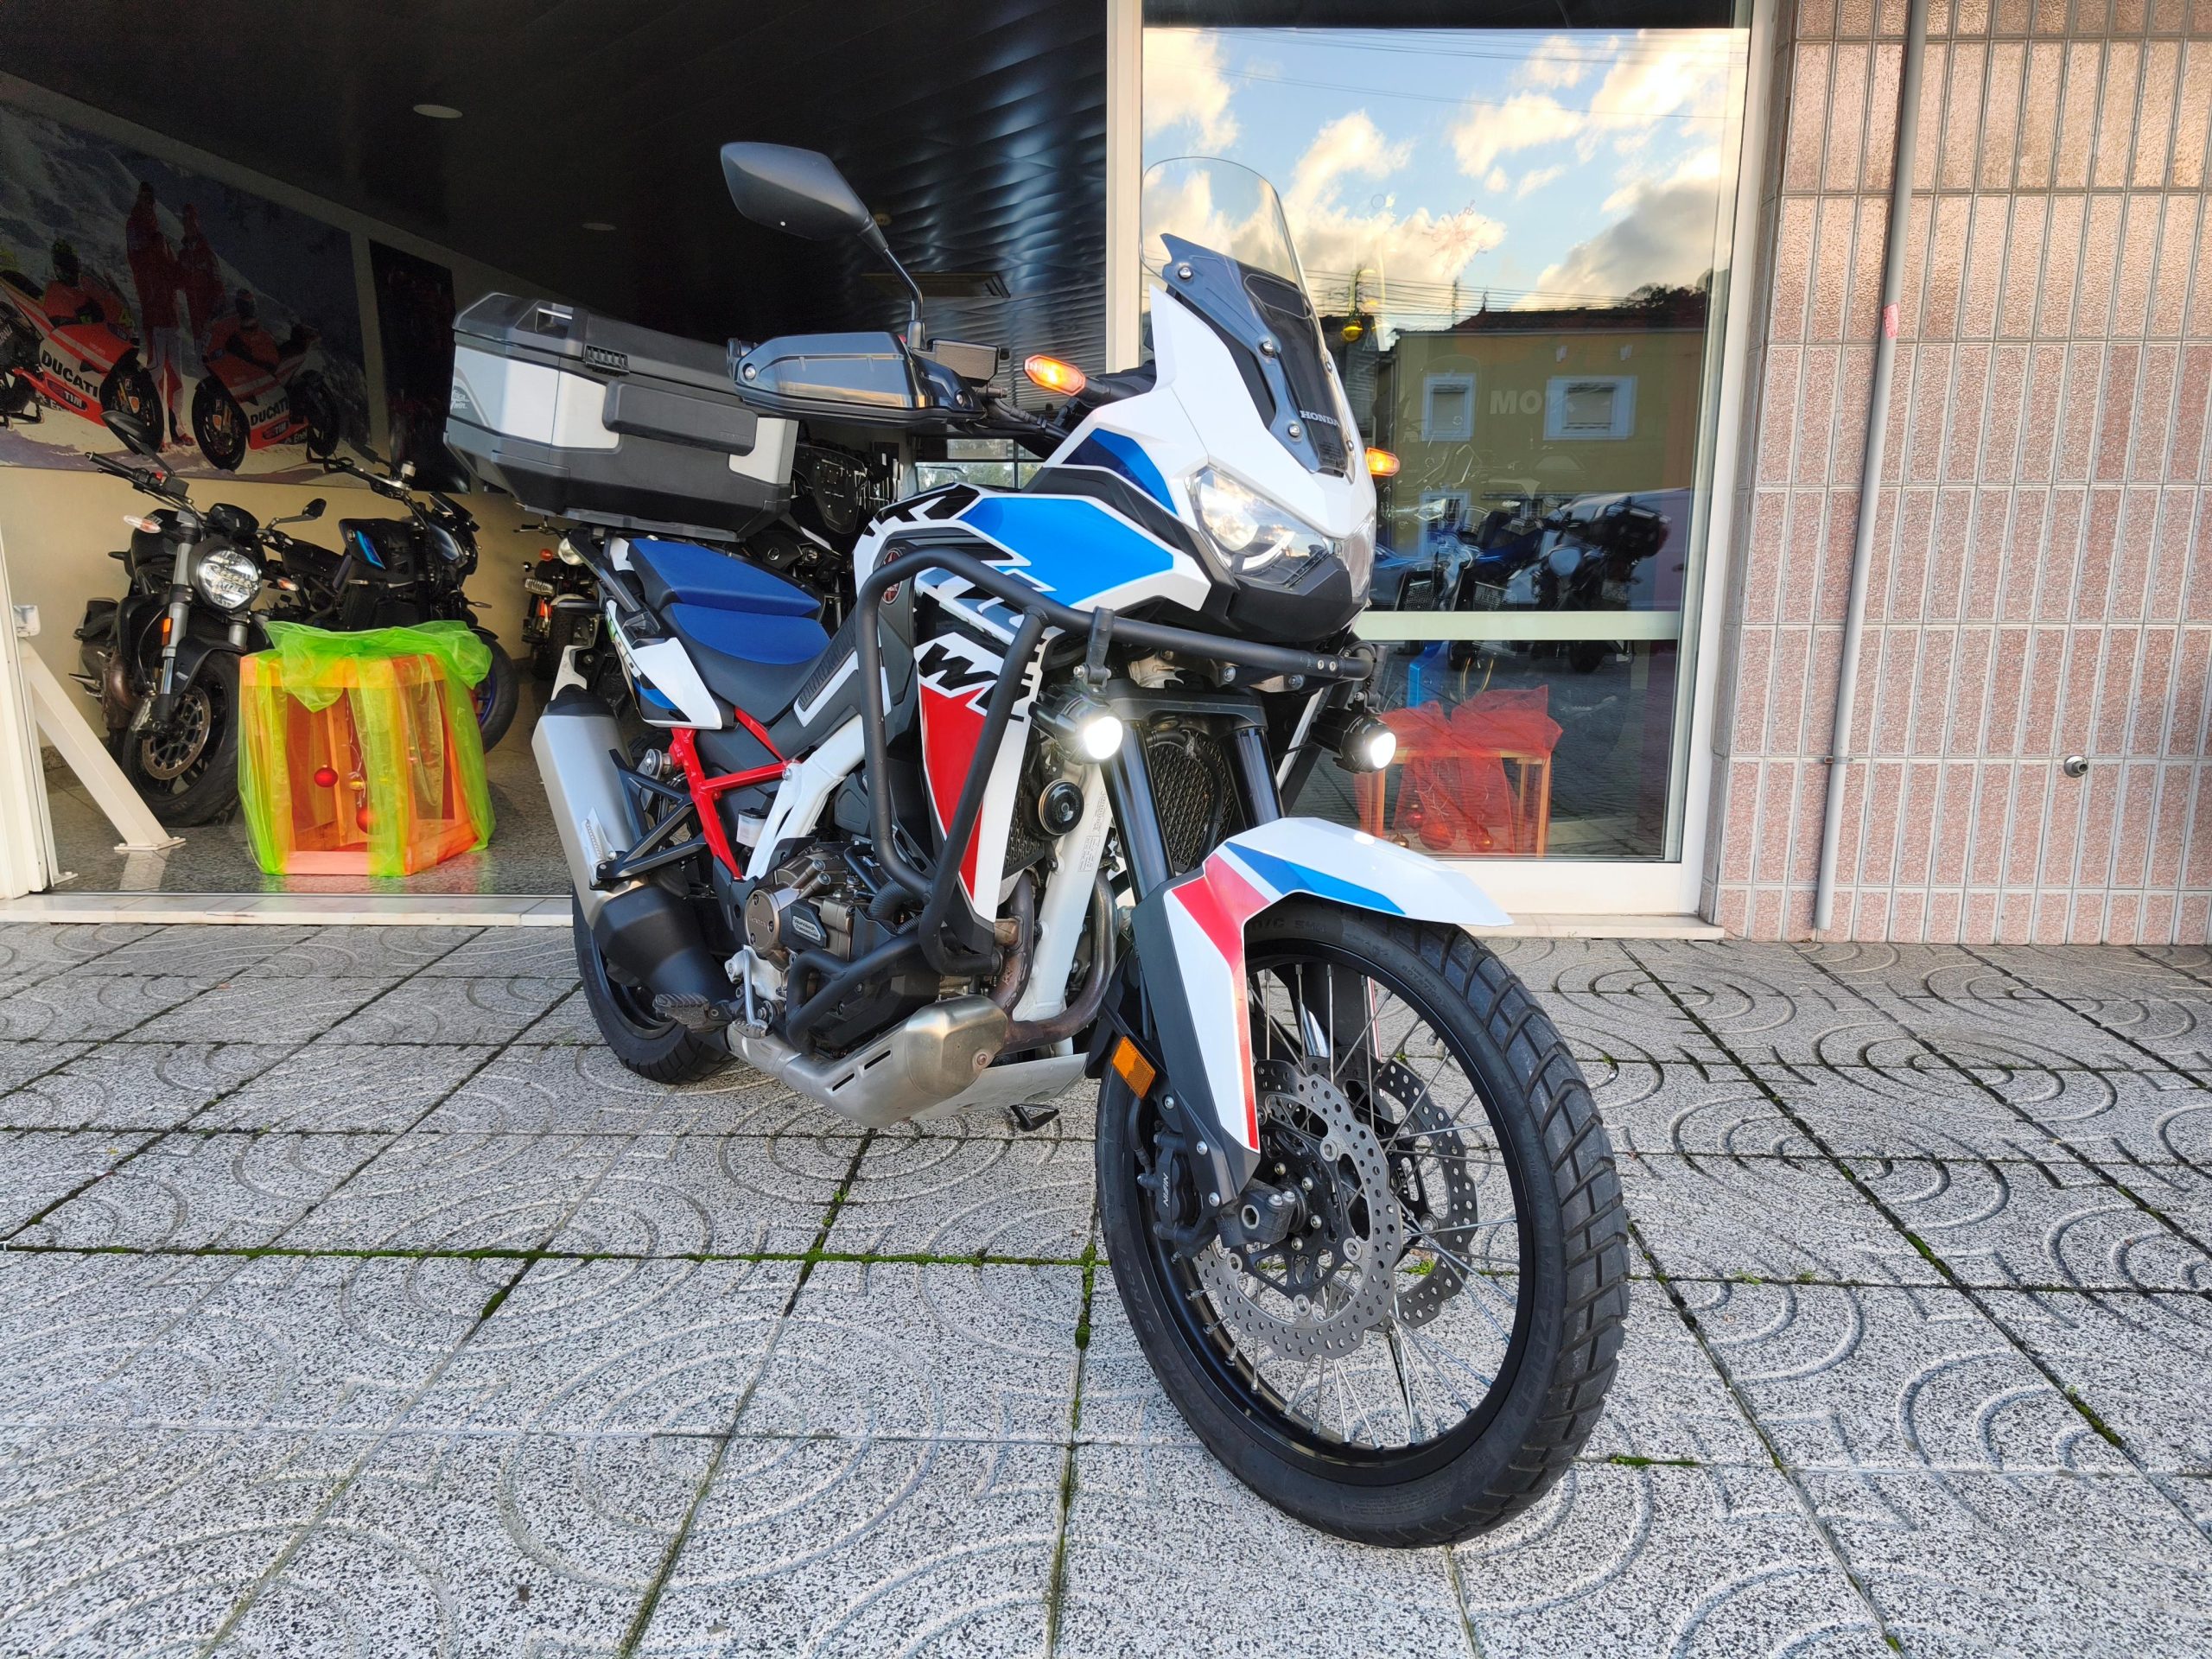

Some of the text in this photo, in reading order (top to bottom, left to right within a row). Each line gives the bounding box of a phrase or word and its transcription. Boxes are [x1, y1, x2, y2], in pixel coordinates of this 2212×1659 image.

[41, 350, 99, 397] DUCATI
[64, 391, 83, 408] TIM
[251, 398, 289, 426] DUCATI
[1299, 410, 1339, 427] HONDA
[276, 422, 287, 435] TIM
[1116, 1245, 1157, 1335] STREET
